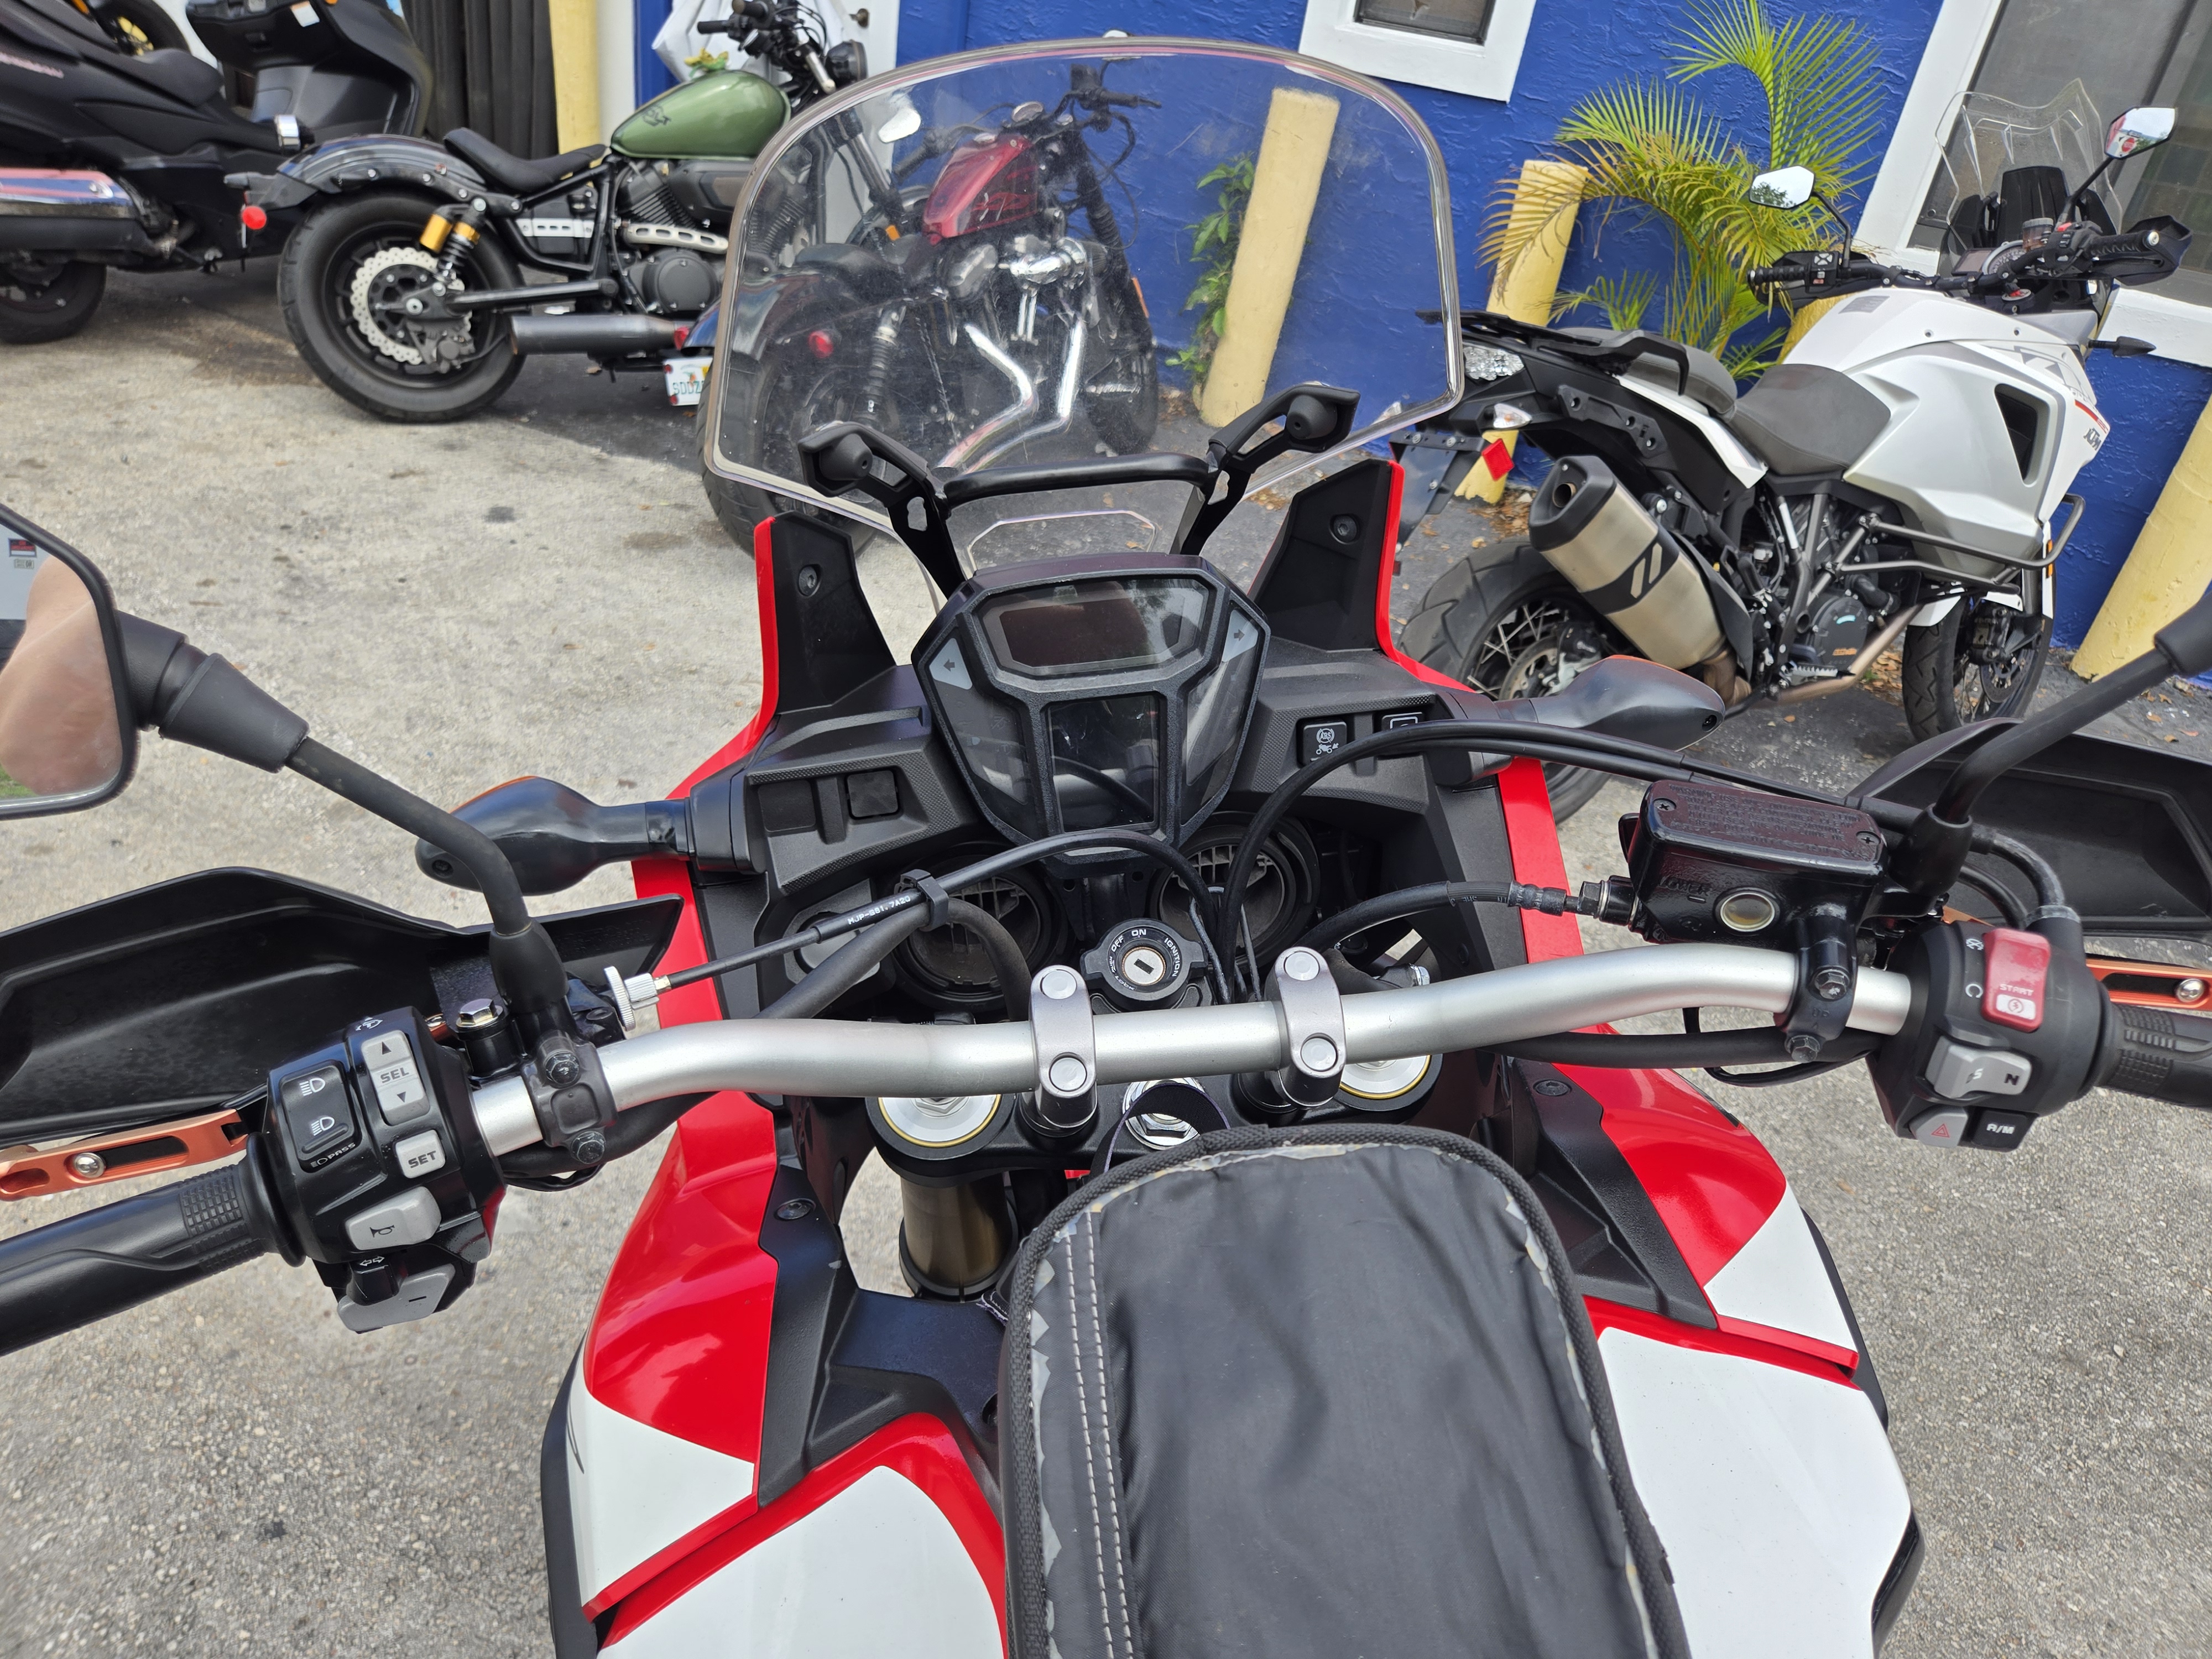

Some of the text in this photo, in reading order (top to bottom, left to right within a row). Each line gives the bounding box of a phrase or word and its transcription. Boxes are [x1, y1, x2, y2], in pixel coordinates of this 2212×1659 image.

[2083, 427, 2101, 451] KTM
[1320, 732, 1331, 740] ABS
[1657, 875, 1712, 896] LOWER
[1111, 935, 1124, 952] OFF
[1164, 937, 1180, 977] IGNITION
[1115, 975, 1135, 990] LOCK
[2000, 984, 2034, 996] START
[380, 1067, 410, 1083] SEL
[2004, 1073, 2020, 1086] N
[1986, 1123, 2015, 1134] A/M
[328, 1142, 356, 1160] PASS
[408, 1150, 437, 1168] SET
